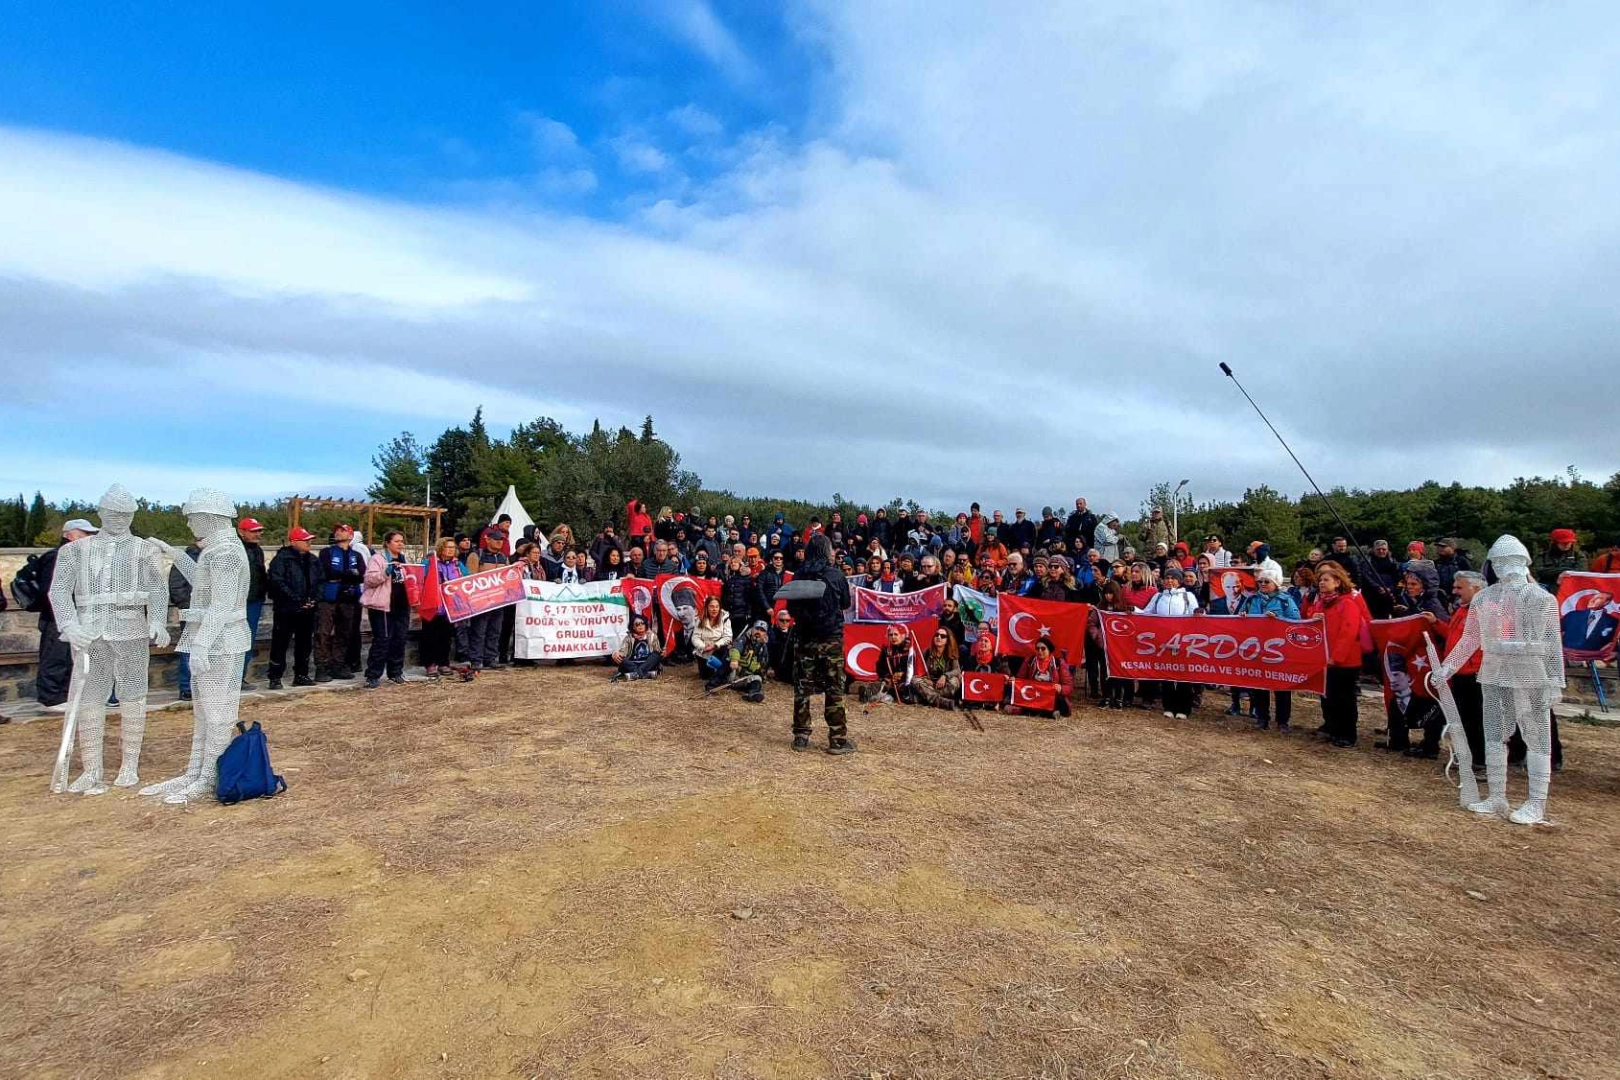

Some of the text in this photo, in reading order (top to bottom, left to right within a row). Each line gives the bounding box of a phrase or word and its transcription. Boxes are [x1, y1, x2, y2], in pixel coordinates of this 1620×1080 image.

[462, 572, 505, 595] ÇADAK
[571, 604, 605, 614] TROYA
[556, 630, 594, 639] GRUBU
[1136, 632, 1286, 664] SARDOS
[1154, 663, 1185, 672] SAROS
[1219, 665, 1232, 675] VE
[1235, 667, 1262, 677] SPOR
